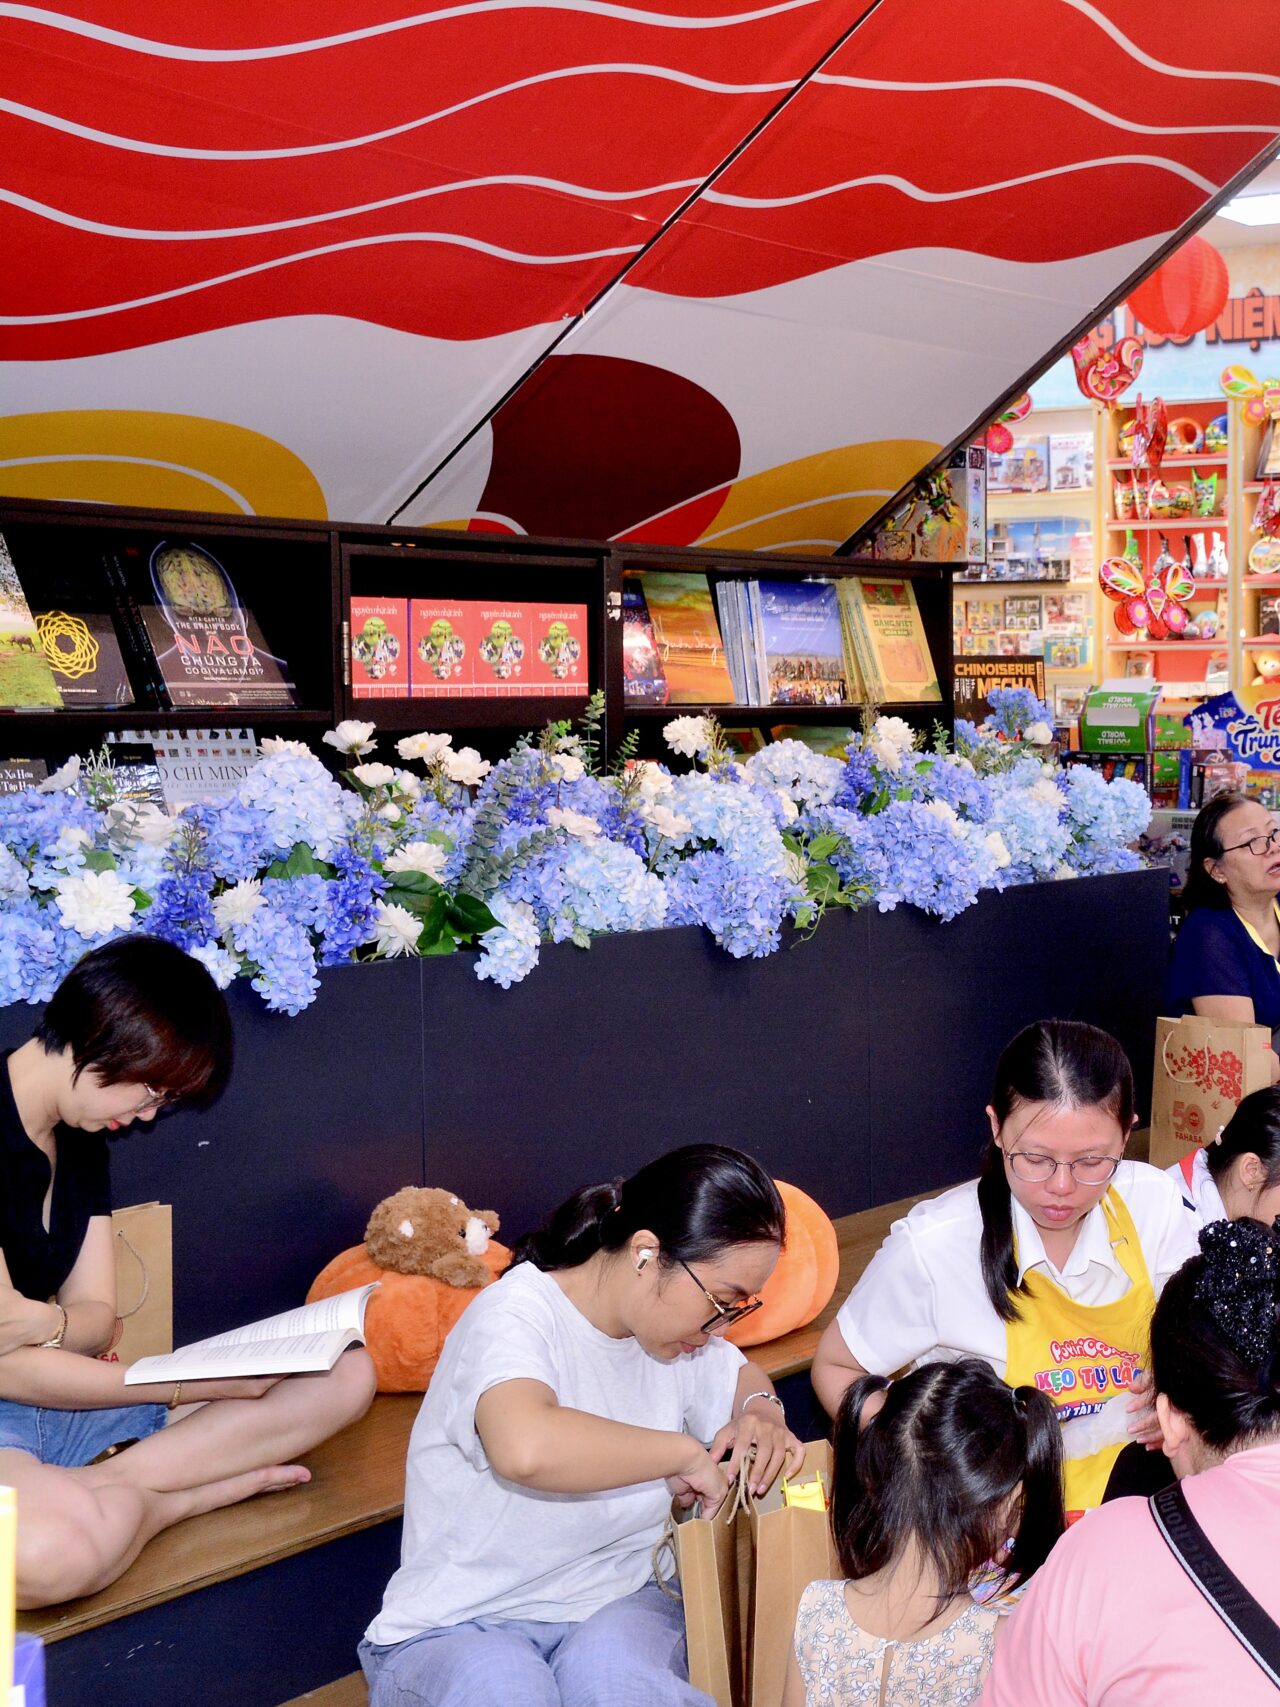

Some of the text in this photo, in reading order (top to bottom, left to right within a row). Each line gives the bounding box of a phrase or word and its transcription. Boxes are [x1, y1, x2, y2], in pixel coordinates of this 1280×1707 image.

[176, 622, 241, 631] THE BRAIN BOOK
[174, 631, 254, 656] NÃO
[181, 655, 261, 667] CHÚNG TA
[954, 663, 1036, 676] CHINOISERIE
[208, 766, 249, 781] MIN
[1171, 1101, 1206, 1134] 50
[1175, 1130, 1204, 1144] FAHASA
[1035, 1368, 1075, 1393] KẸO
[1080, 1365, 1107, 1389] TỰ
[1073, 1402, 1092, 1416] TÀI
